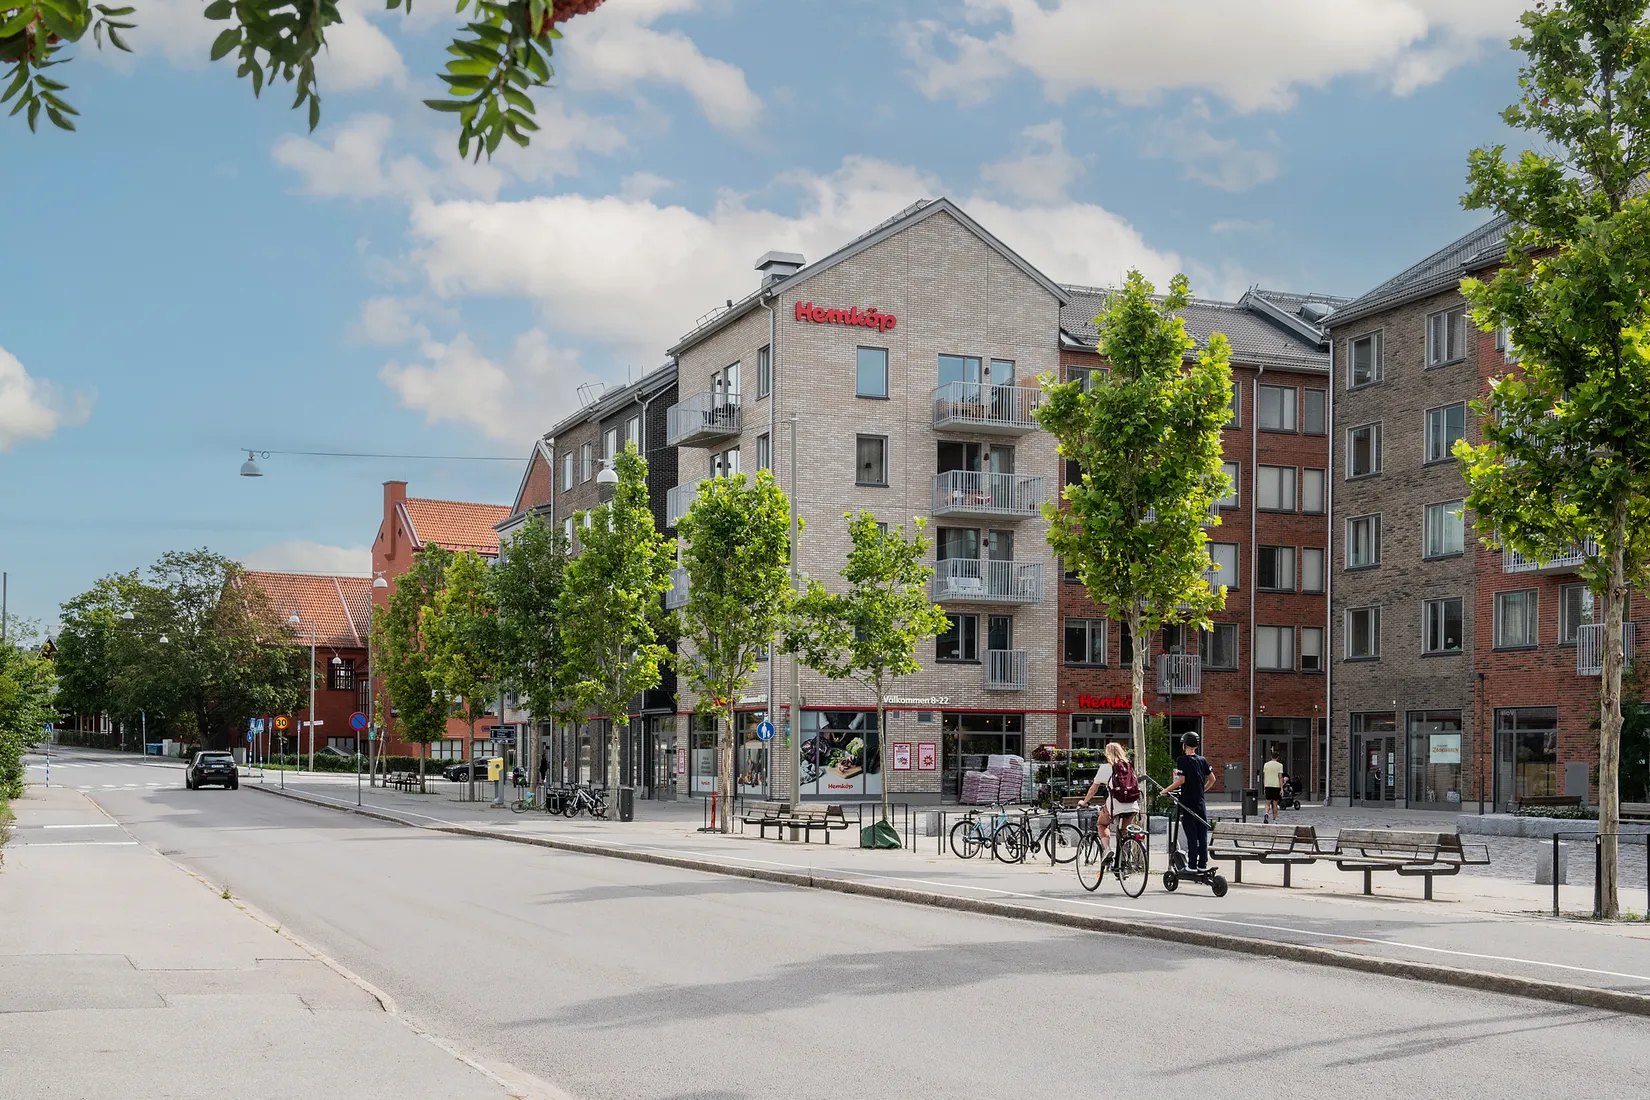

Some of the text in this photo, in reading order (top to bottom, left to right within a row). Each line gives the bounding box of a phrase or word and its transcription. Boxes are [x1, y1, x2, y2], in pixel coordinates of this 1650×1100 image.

[795, 300, 897, 332] Hemköp
[883, 695, 949, 705] Välkommen 8-22
[1079, 693, 1147, 709] Hemkö
[276, 719, 287, 727] 30
